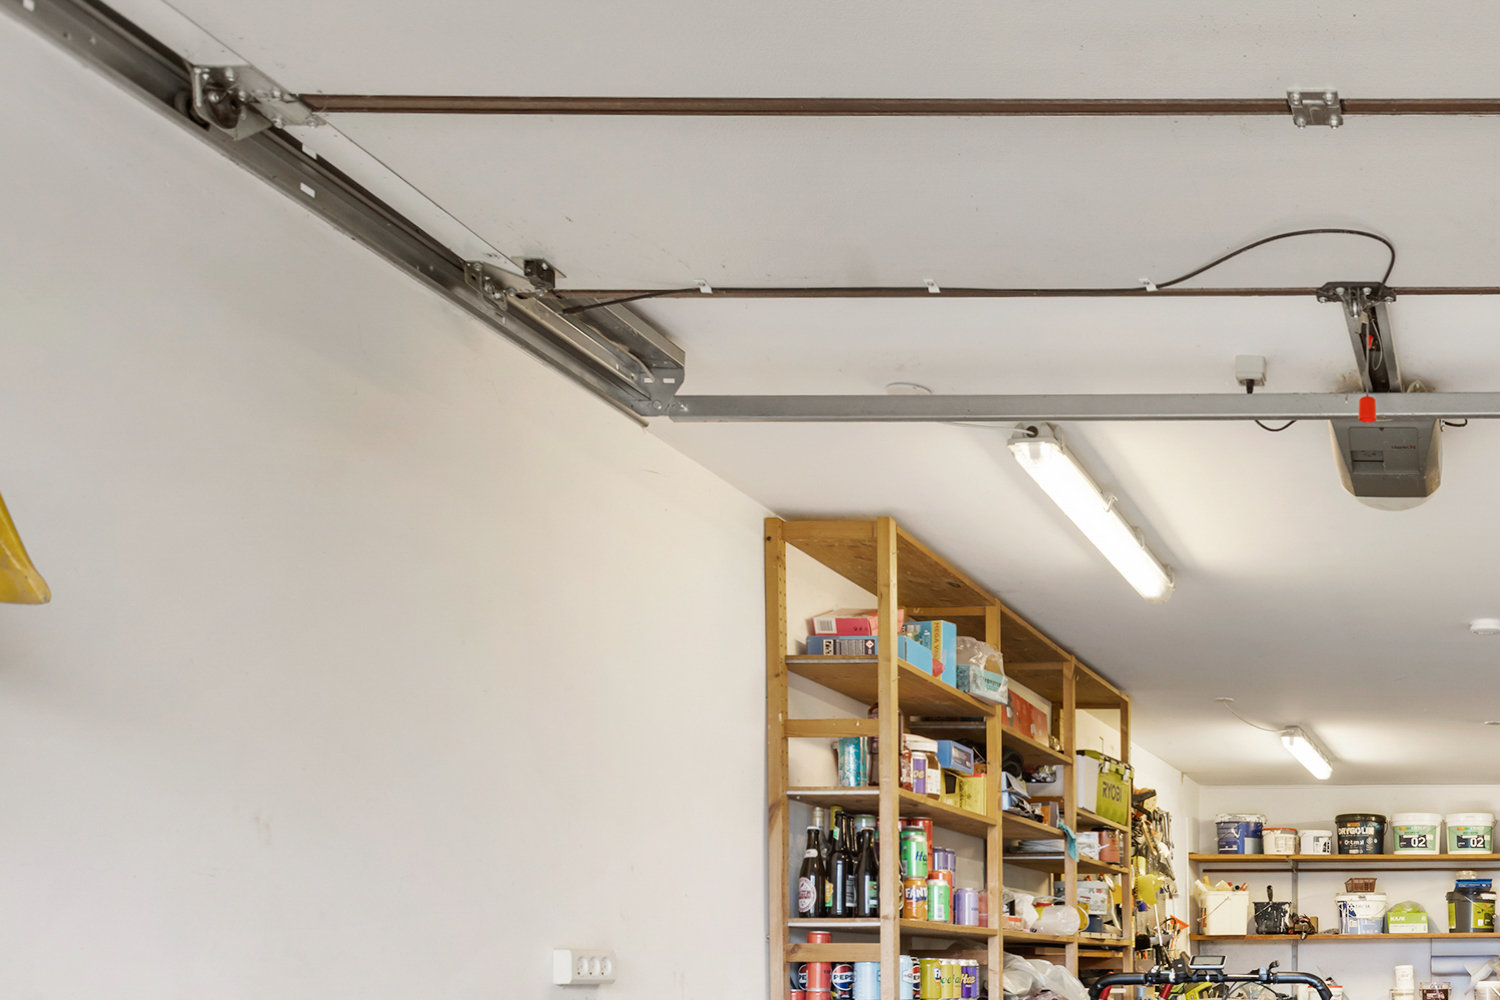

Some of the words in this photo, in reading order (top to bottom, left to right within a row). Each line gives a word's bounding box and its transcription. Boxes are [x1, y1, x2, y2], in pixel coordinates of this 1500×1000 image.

[1101, 781, 1122, 802] RYOBI
[1411, 837, 1426, 848] 02
[1470, 837, 1484, 848] 02
[905, 887, 928, 899] FANT
